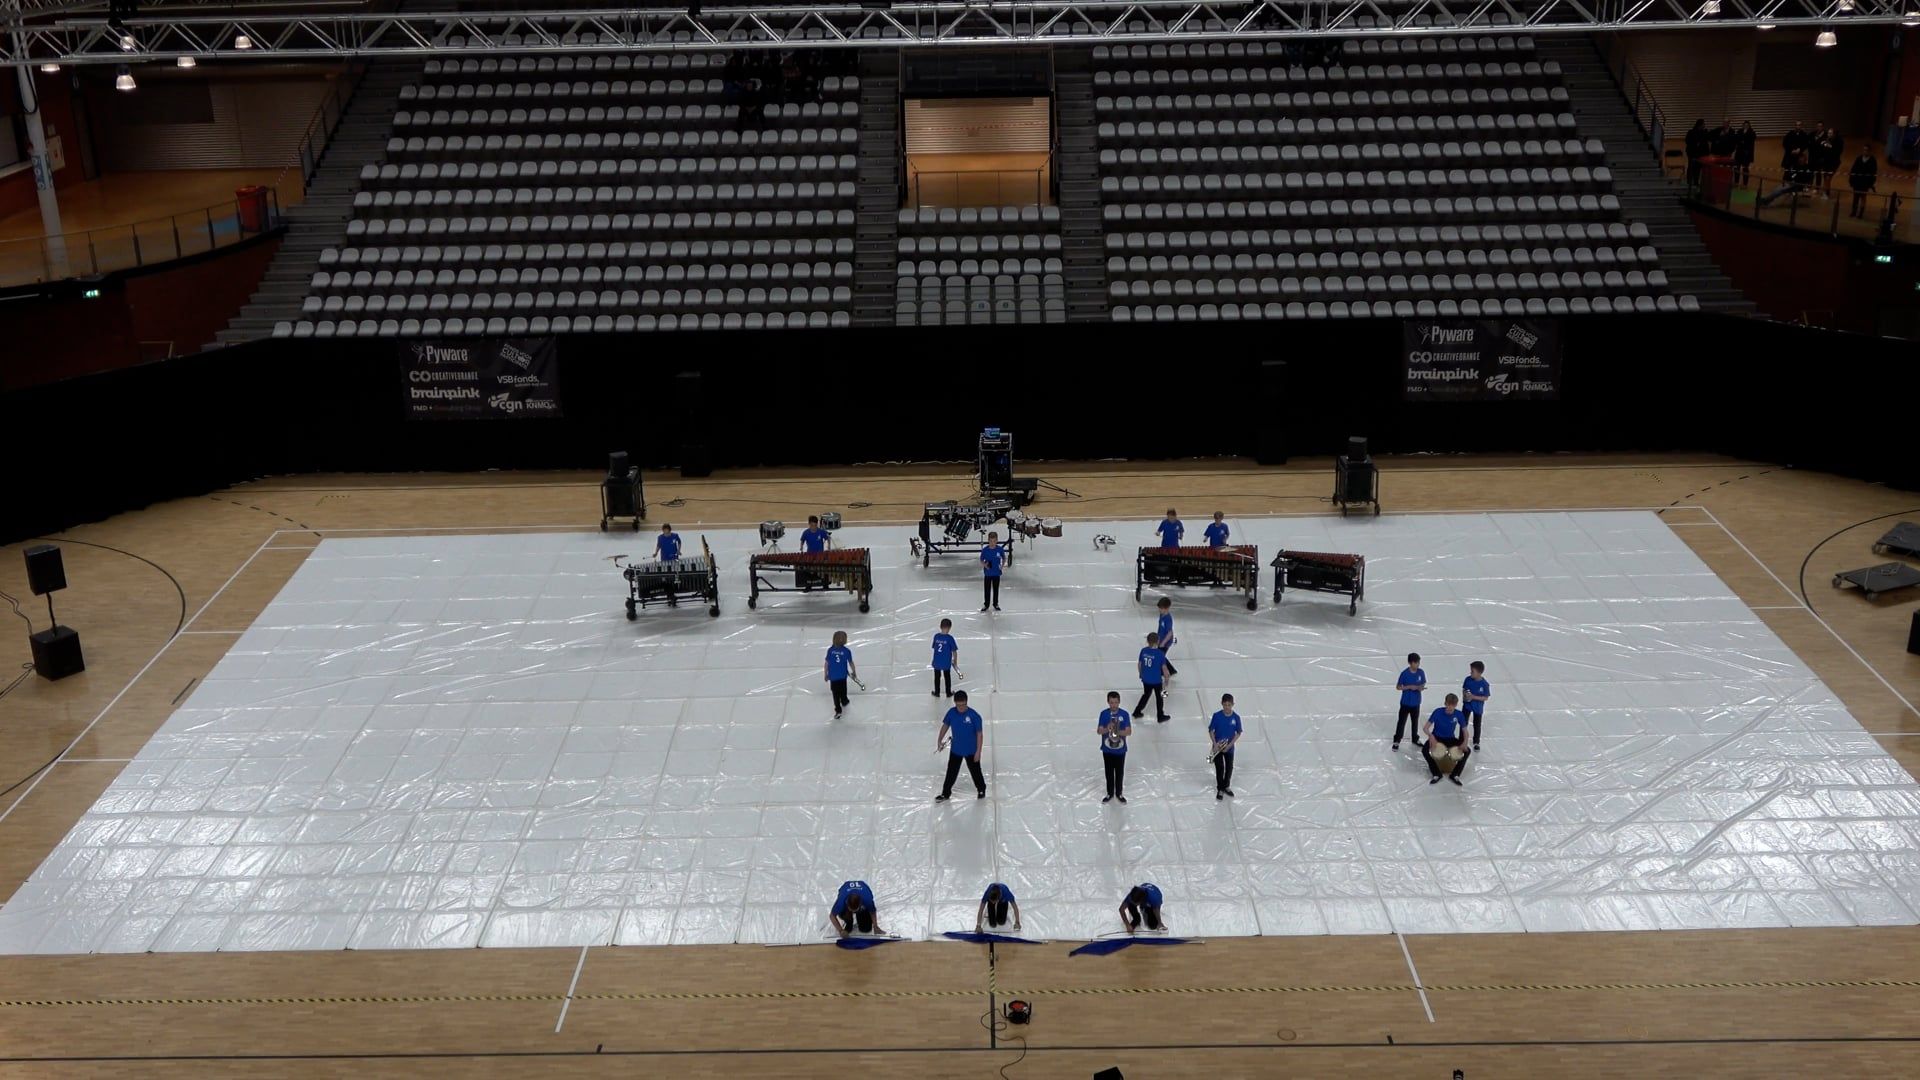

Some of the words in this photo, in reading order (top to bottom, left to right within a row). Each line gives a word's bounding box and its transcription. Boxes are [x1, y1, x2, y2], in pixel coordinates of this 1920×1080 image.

[1431, 325, 1474, 345] Pyware
[426, 345, 468, 364] Pyware
[1407, 367, 1479, 382] brainpink
[410, 386, 480, 400] brainpink
[1495, 382, 1519, 395] cgn
[499, 400, 523, 413] cgn
[937, 643, 943, 653] 2
[835, 654, 841, 663] 3
[1143, 657, 1153, 668] 10
